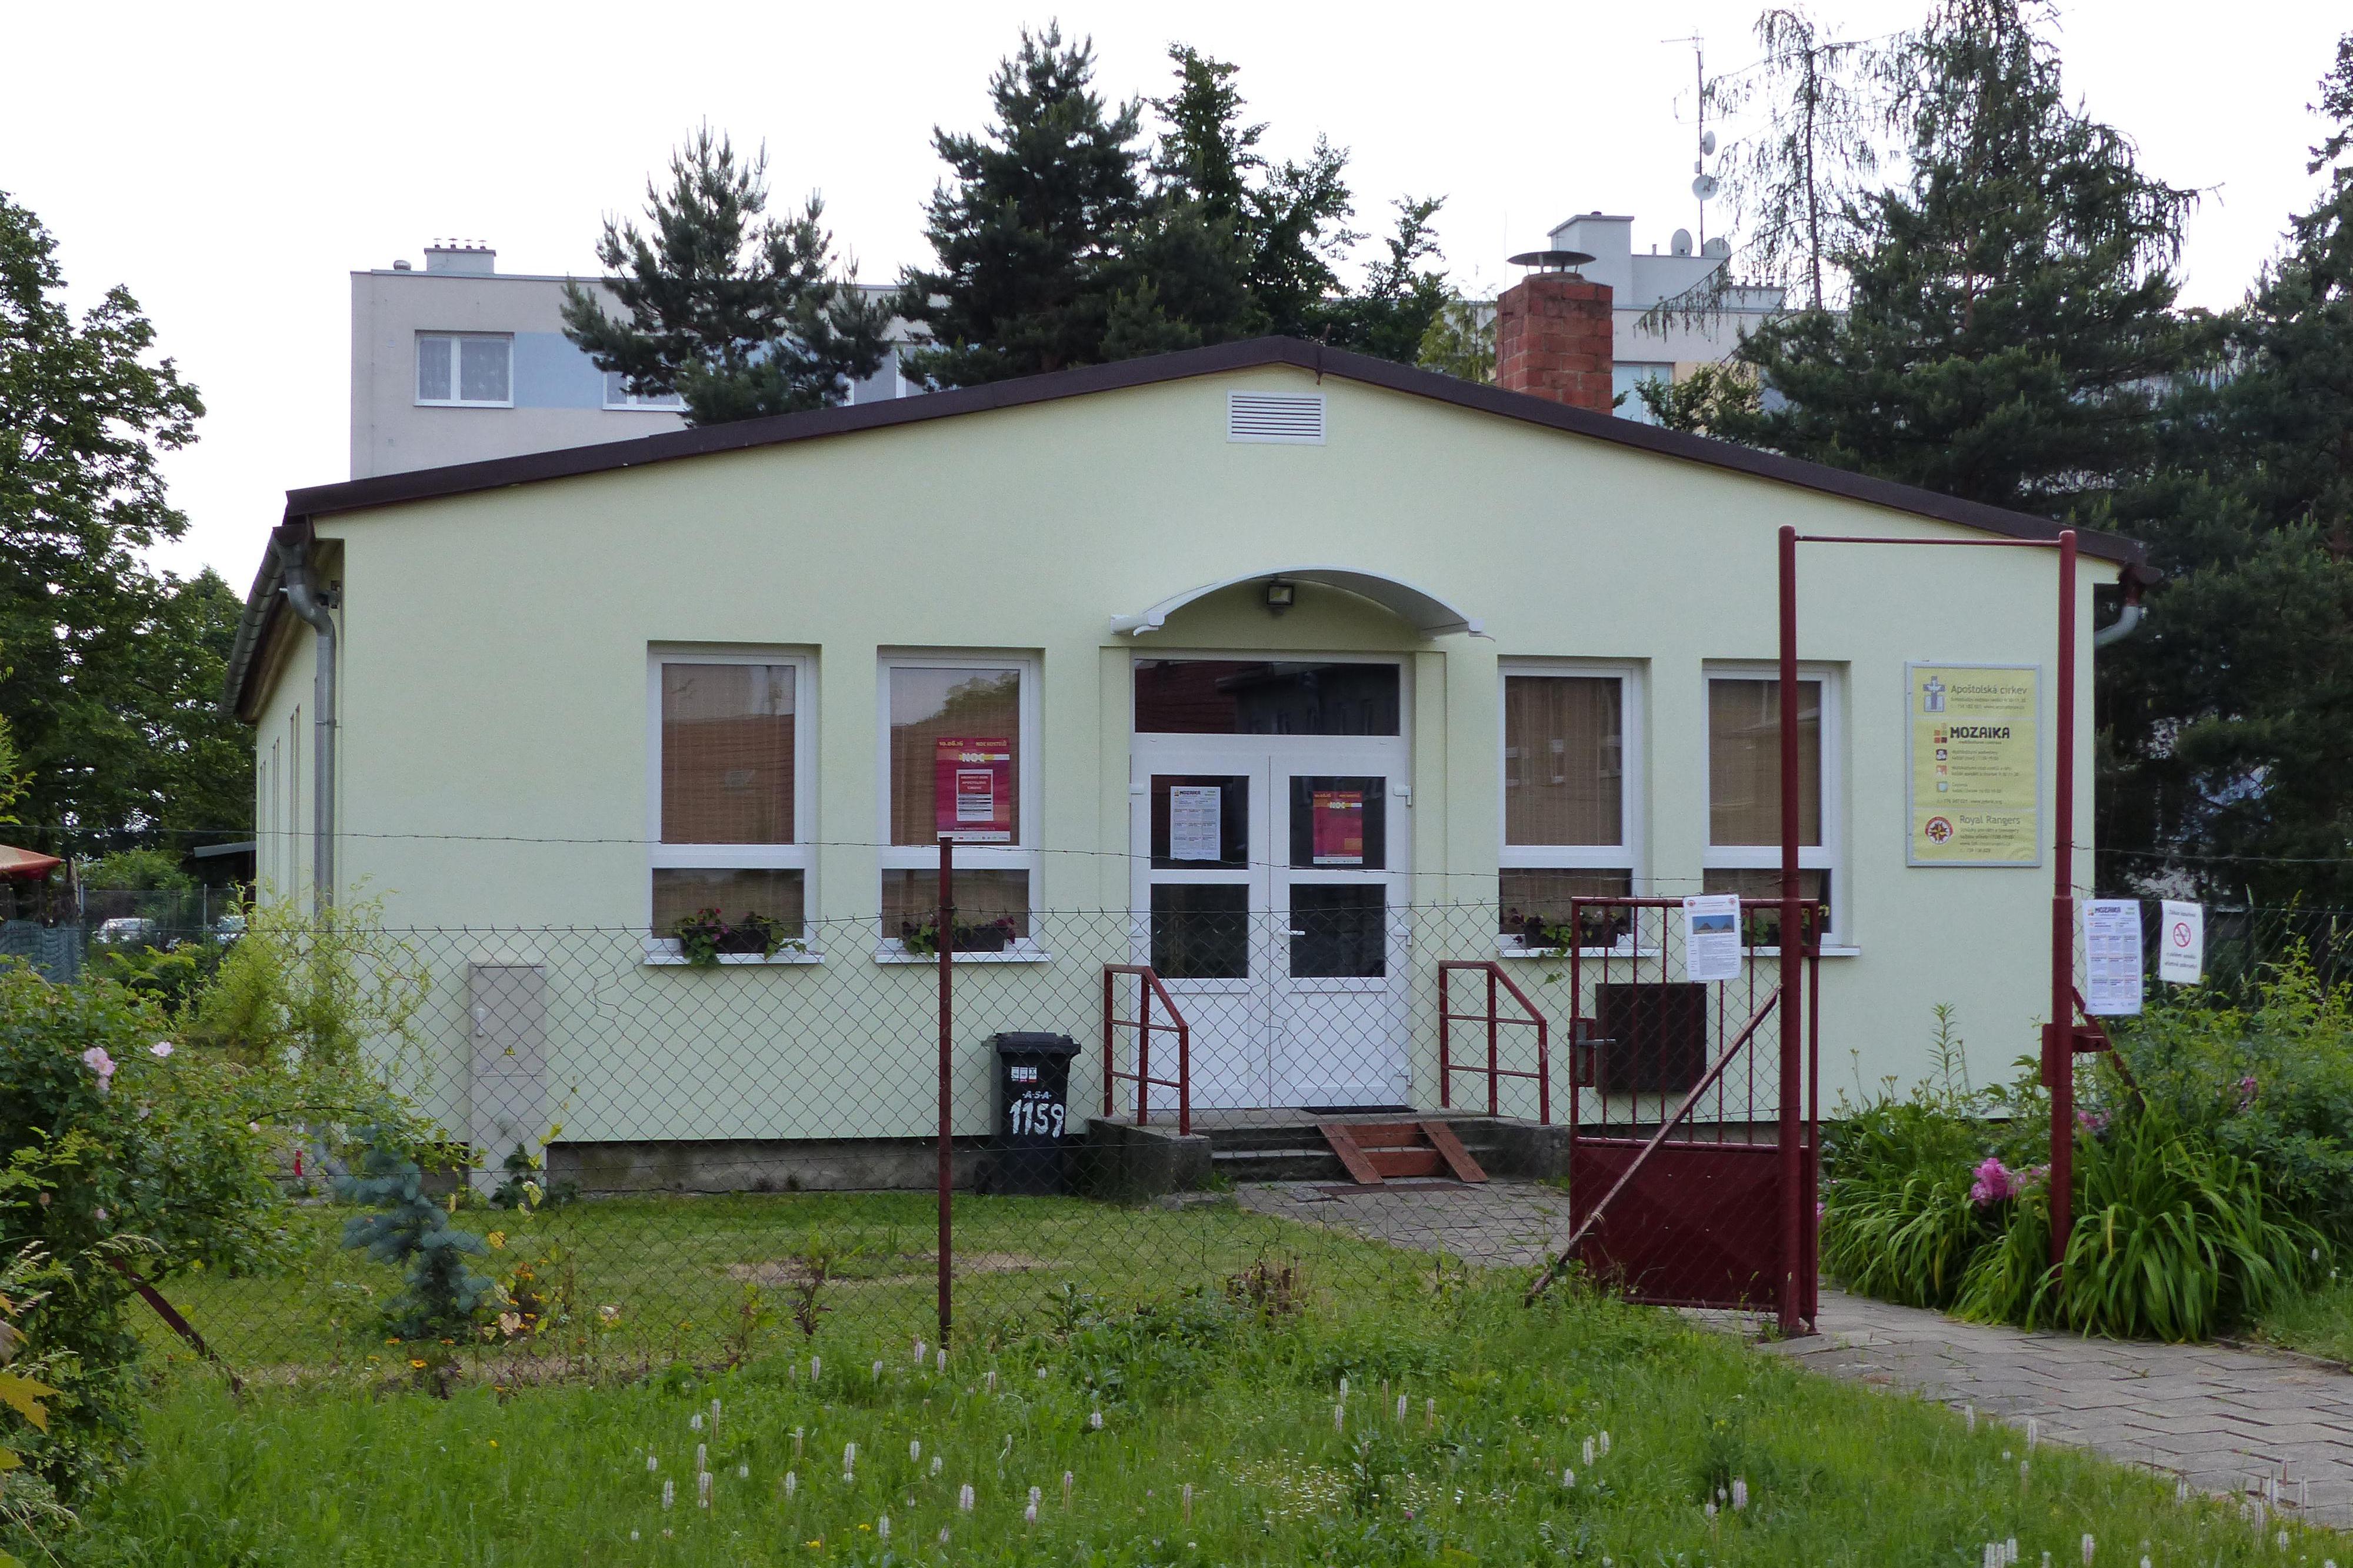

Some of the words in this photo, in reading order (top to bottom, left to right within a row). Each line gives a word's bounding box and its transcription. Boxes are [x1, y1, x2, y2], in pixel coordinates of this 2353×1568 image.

[1951, 684, 1997, 695] Apoštolská
[1950, 726, 2011, 739] MOZAIKA
[1959, 815, 1984, 826] Royal
[1986, 816, 2021, 826] Rangers
[1009, 1099, 1064, 1138] 1159
